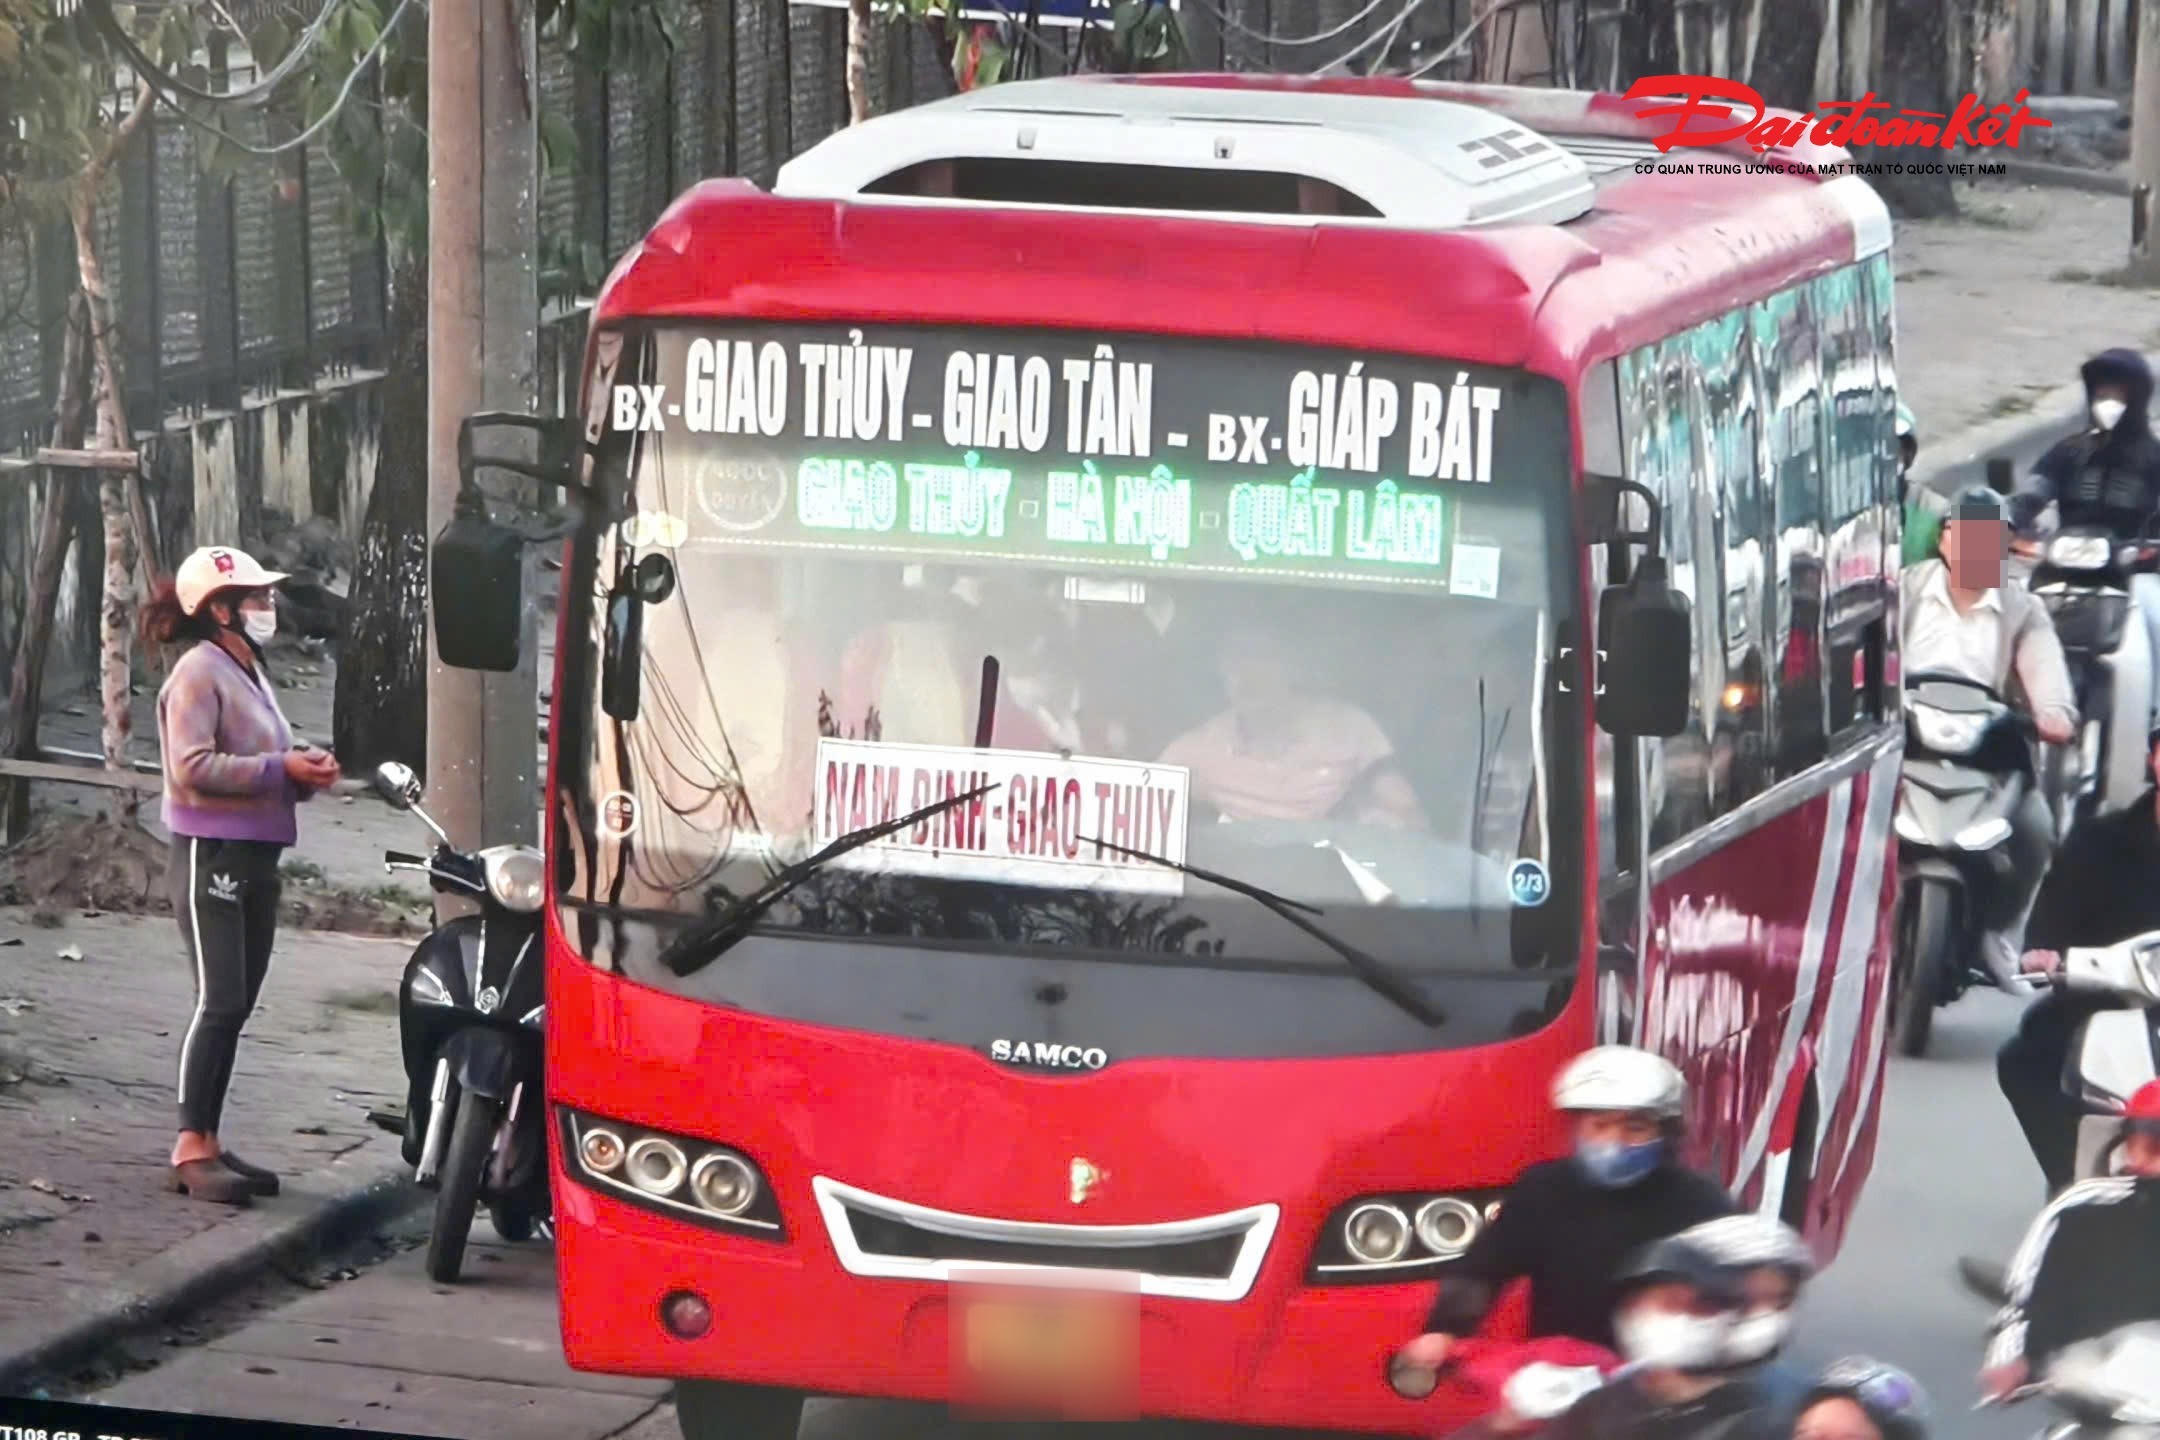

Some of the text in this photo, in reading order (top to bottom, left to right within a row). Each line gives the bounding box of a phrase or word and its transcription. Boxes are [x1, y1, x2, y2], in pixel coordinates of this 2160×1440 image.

[944, 350, 1051, 452] GIAO
[1063, 344, 1153, 457] TÂN
[1408, 372, 1501, 482] BÁT
[797, 457, 897, 532] GIAO
[904, 450, 1012, 537] THỦY
[1047, 459, 1107, 543] HÀ
[1114, 464, 1191, 560] NỘI
[1228, 464, 1340, 561] QUẤT
[1346, 479, 1442, 565] LÂM
[825, 760, 900, 843] NAM
[1094, 768, 1175, 864] THỦY
[1515, 873, 1543, 892] 2/3
[991, 1039, 1107, 1070] SAMCO
